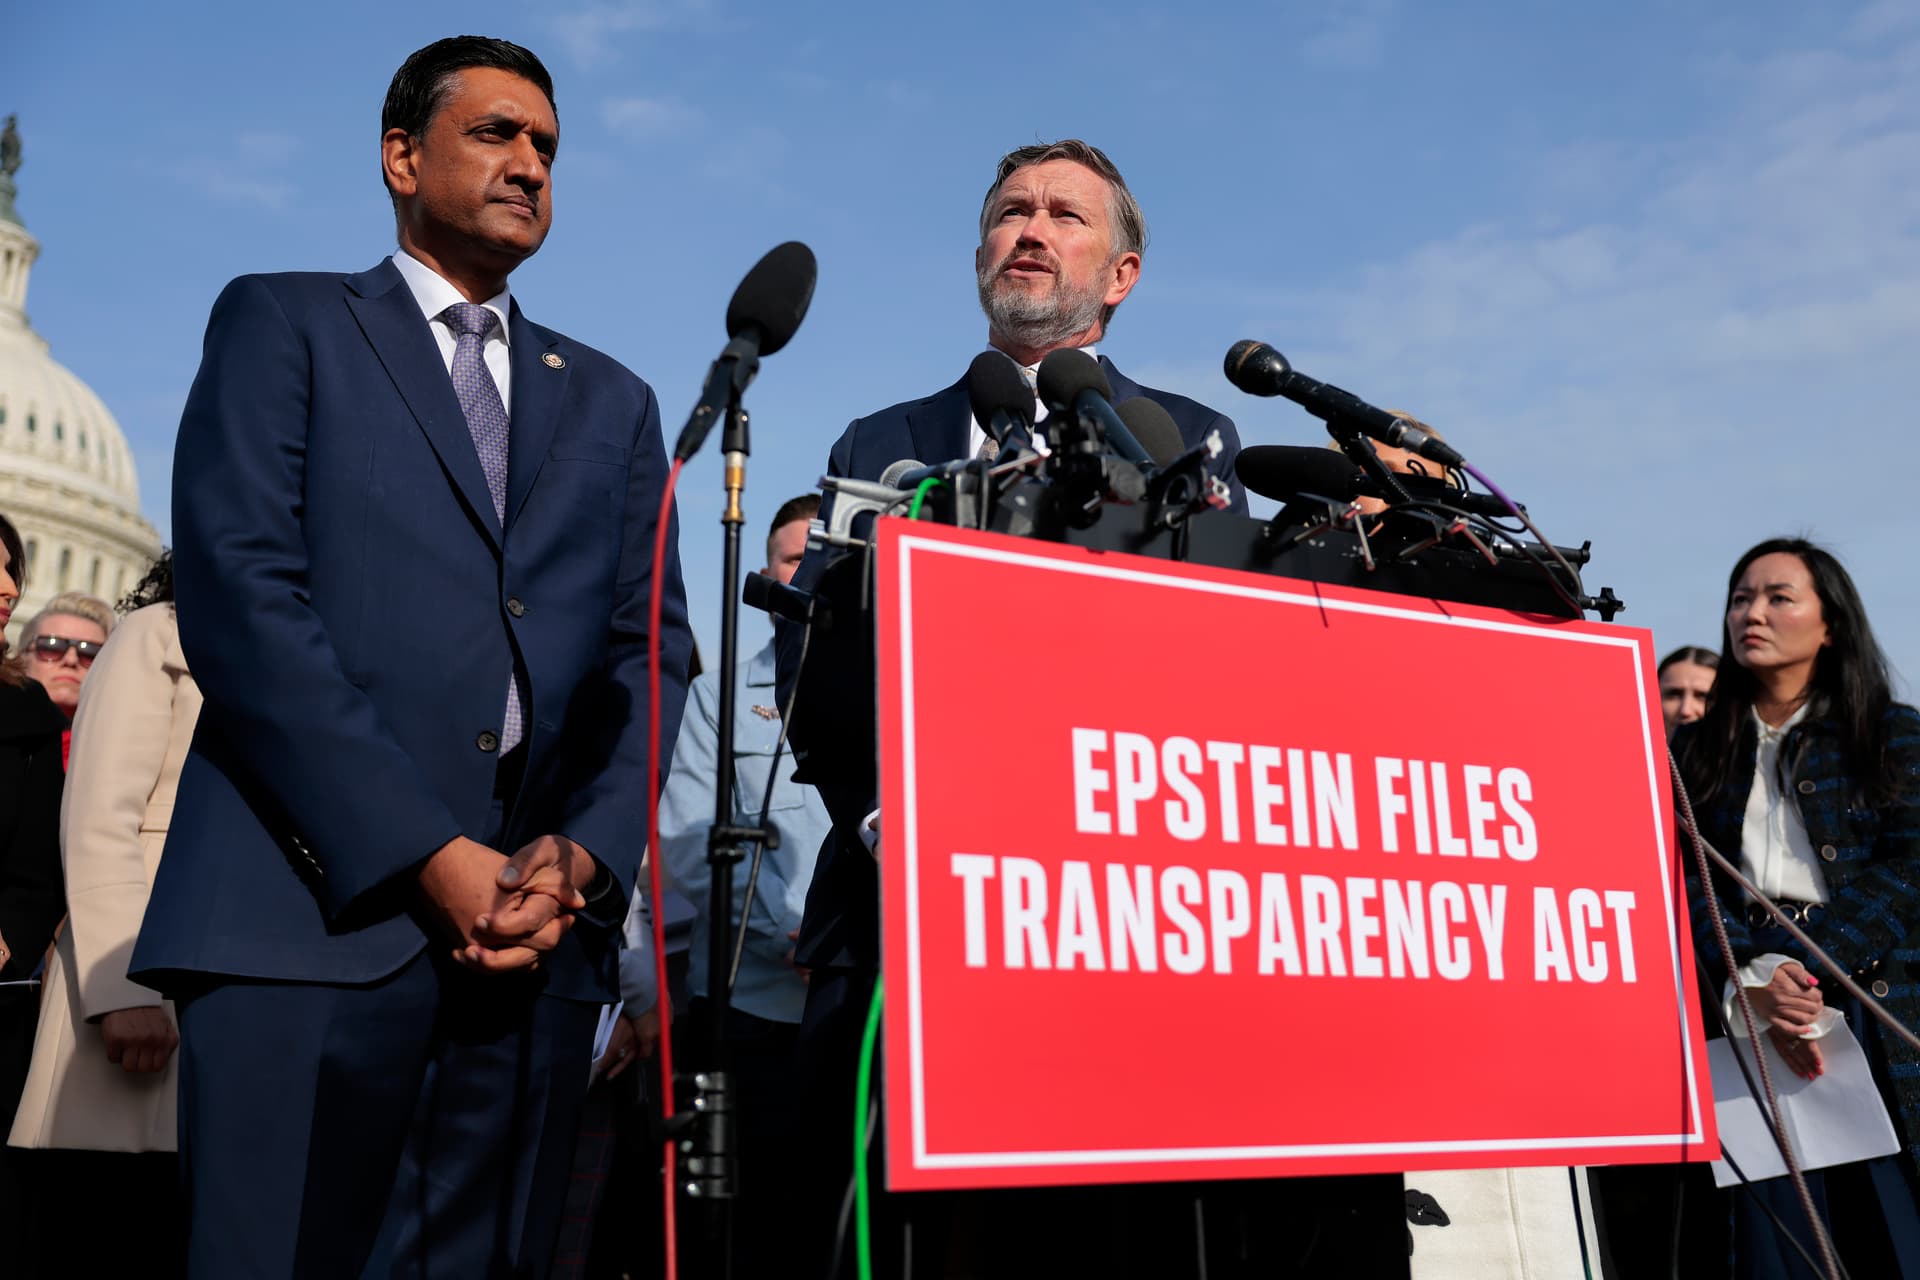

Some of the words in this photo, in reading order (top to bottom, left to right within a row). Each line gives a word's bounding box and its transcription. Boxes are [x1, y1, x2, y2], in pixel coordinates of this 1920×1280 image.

[1071, 727, 1359, 850] EPSTEIN
[1374, 756, 1538, 862] FILES
[951, 853, 1507, 981] TRANSPARENCY
[1533, 886, 1637, 983] ACT
